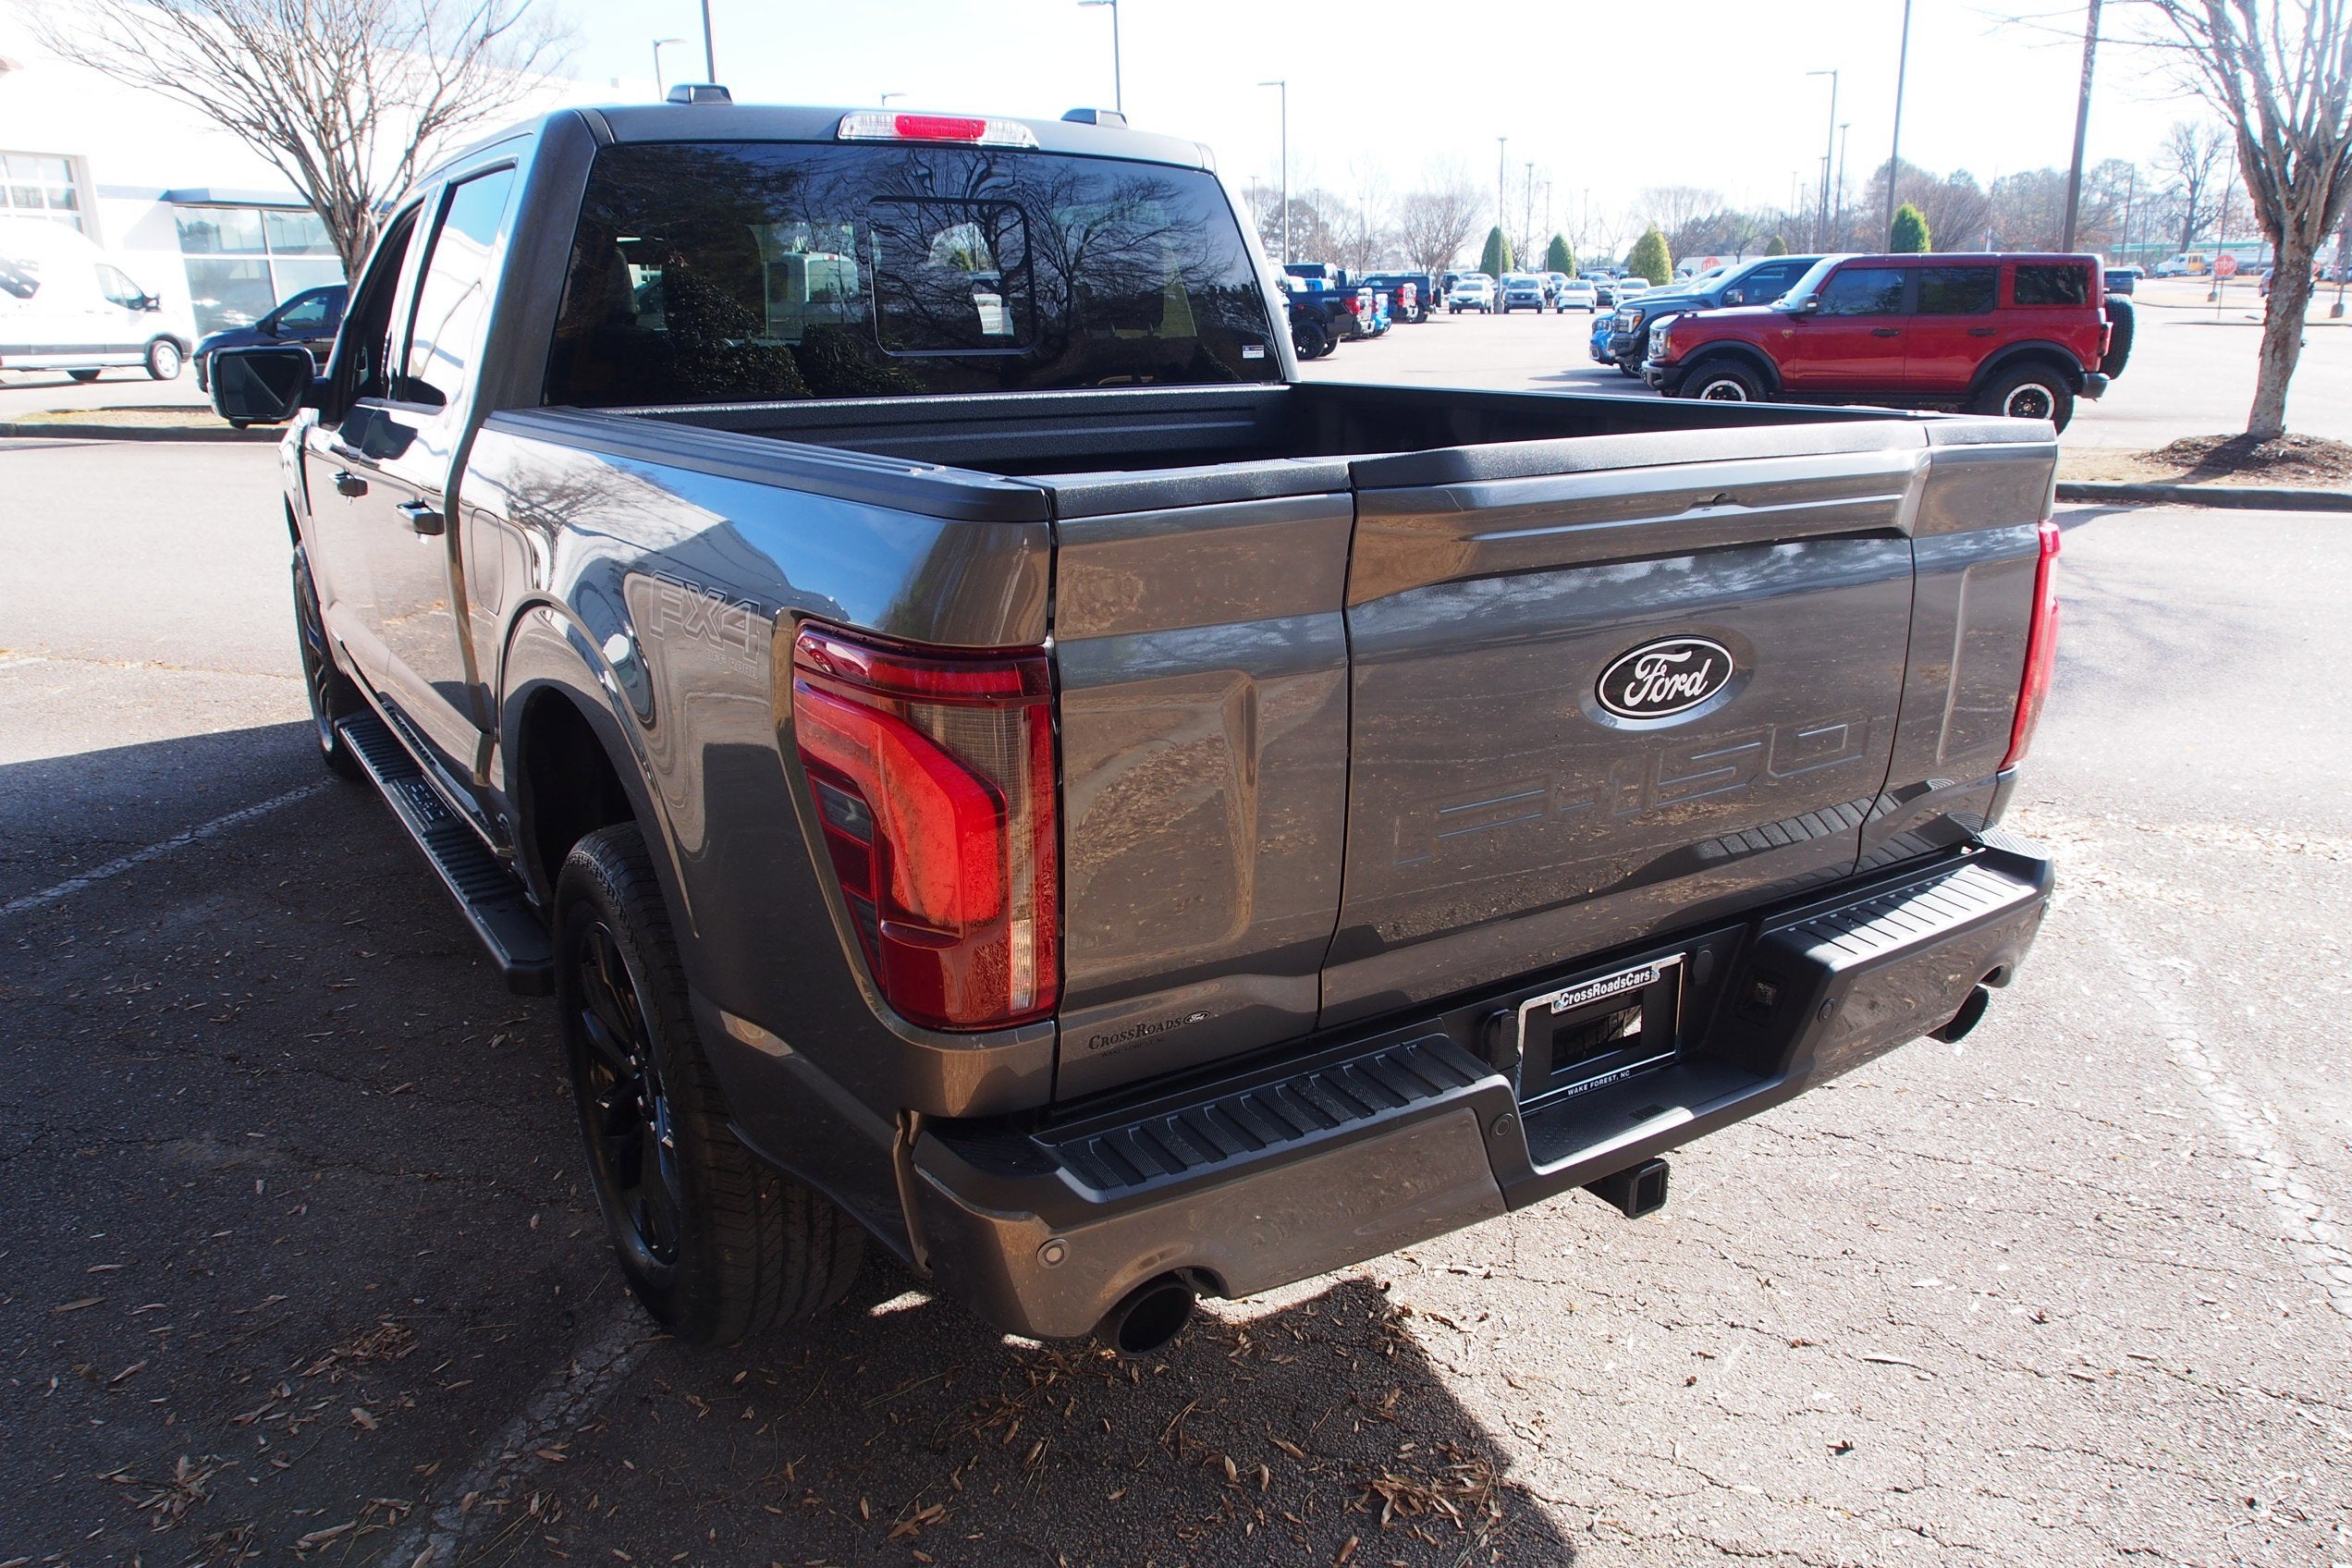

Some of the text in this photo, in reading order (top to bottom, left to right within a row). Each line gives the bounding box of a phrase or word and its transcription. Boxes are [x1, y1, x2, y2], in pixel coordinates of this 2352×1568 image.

[2213, 260, 2235, 270] STOP
[650, 570, 760, 664] FX4
[1623, 650, 1712, 707] Ford
[1561, 970, 1651, 1007] CrossRoadsCars
[1567, 1070, 1630, 1096] WAKE FOREST, NC
